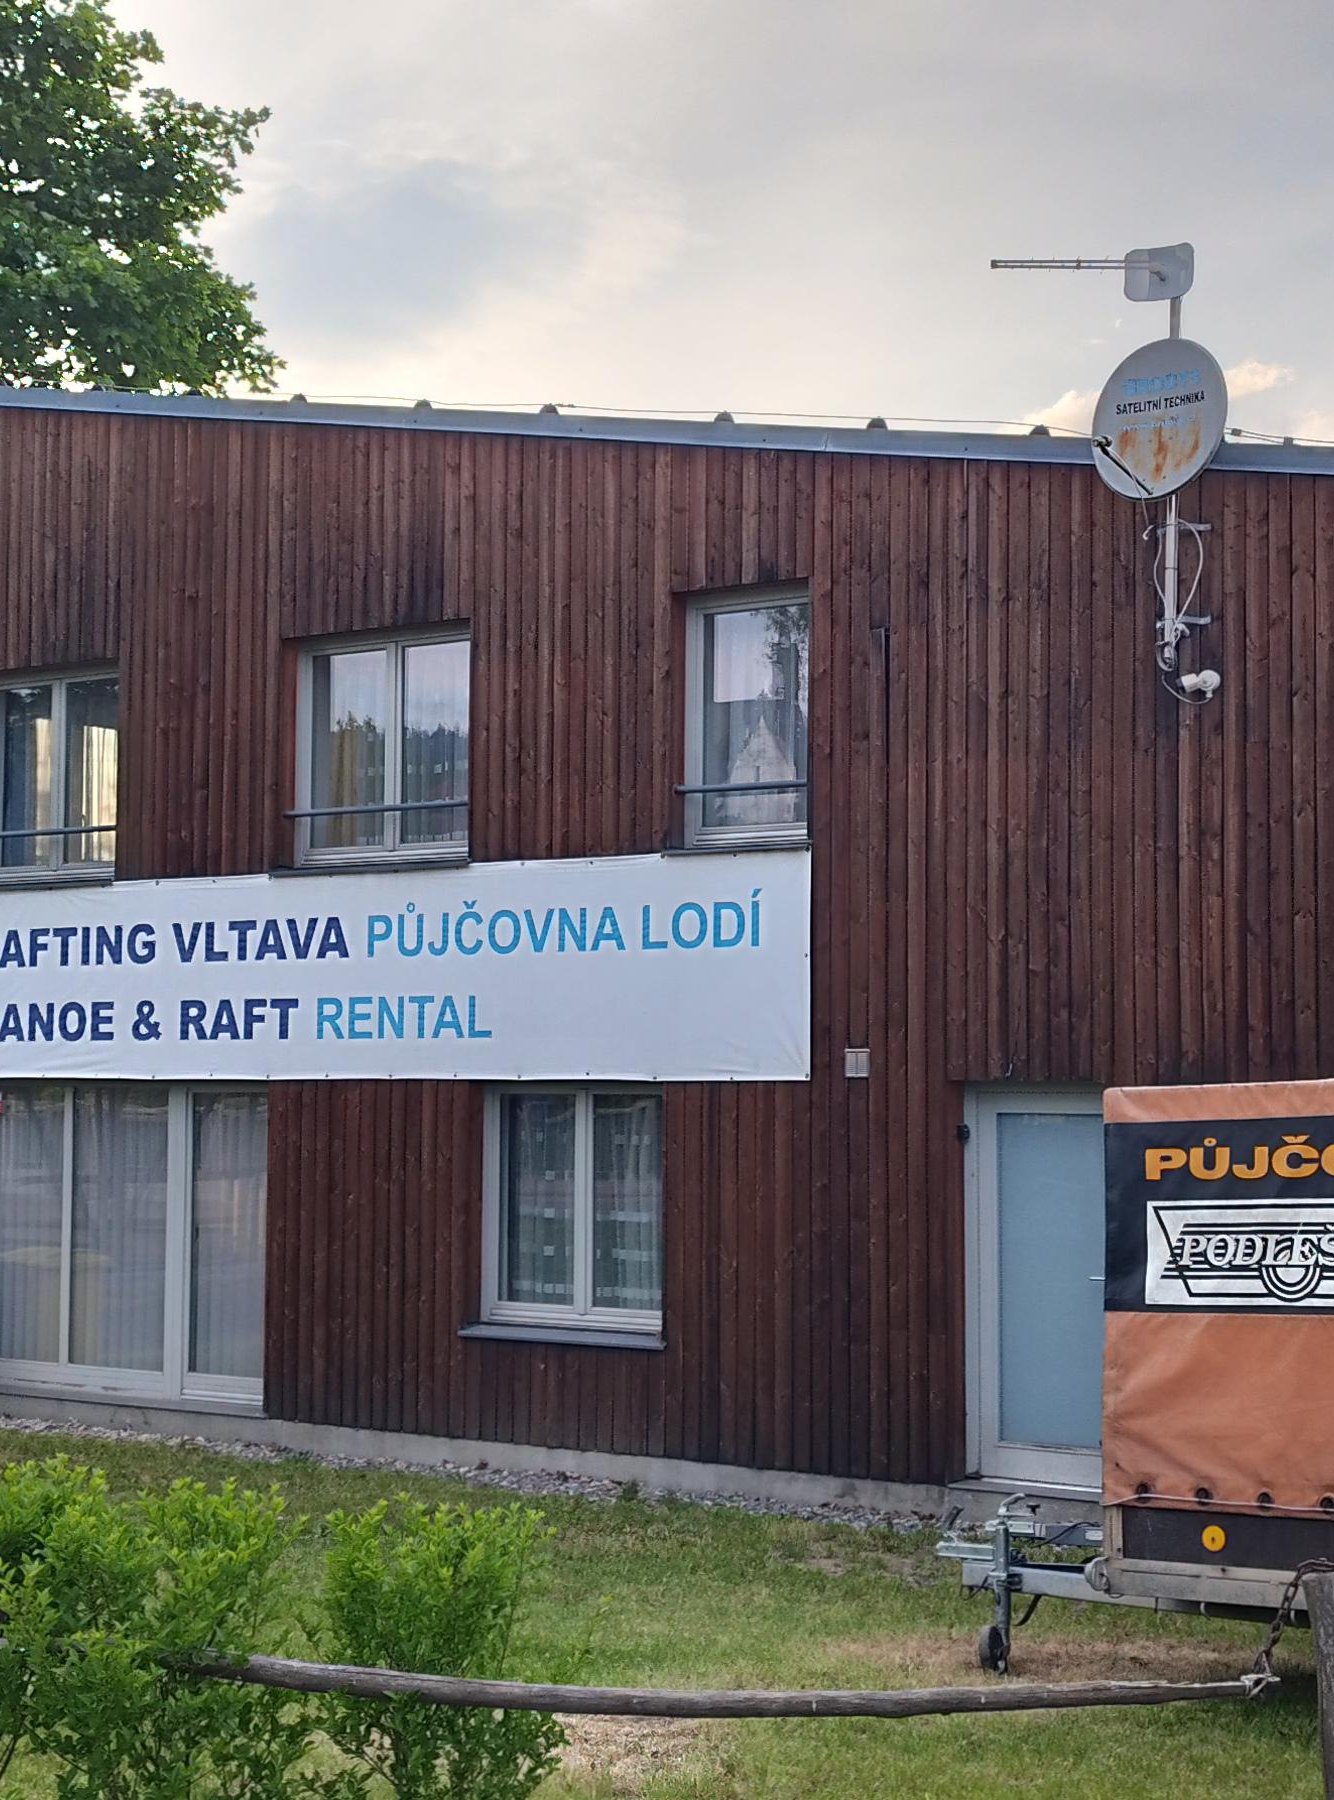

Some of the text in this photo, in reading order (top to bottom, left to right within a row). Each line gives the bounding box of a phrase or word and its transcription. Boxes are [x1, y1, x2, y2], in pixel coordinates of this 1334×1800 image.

[1116, 390, 1205, 415] SATELITNÍ TECHNIKA
[175, 917, 350, 963] VLTAVA
[367, 901, 625, 958] PŮJČOVNA
[642, 888, 762, 951] LODÍ
[131, 998, 162, 1040] &
[179, 997, 299, 1041] RAFT
[316, 995, 493, 1040] RENTAL
